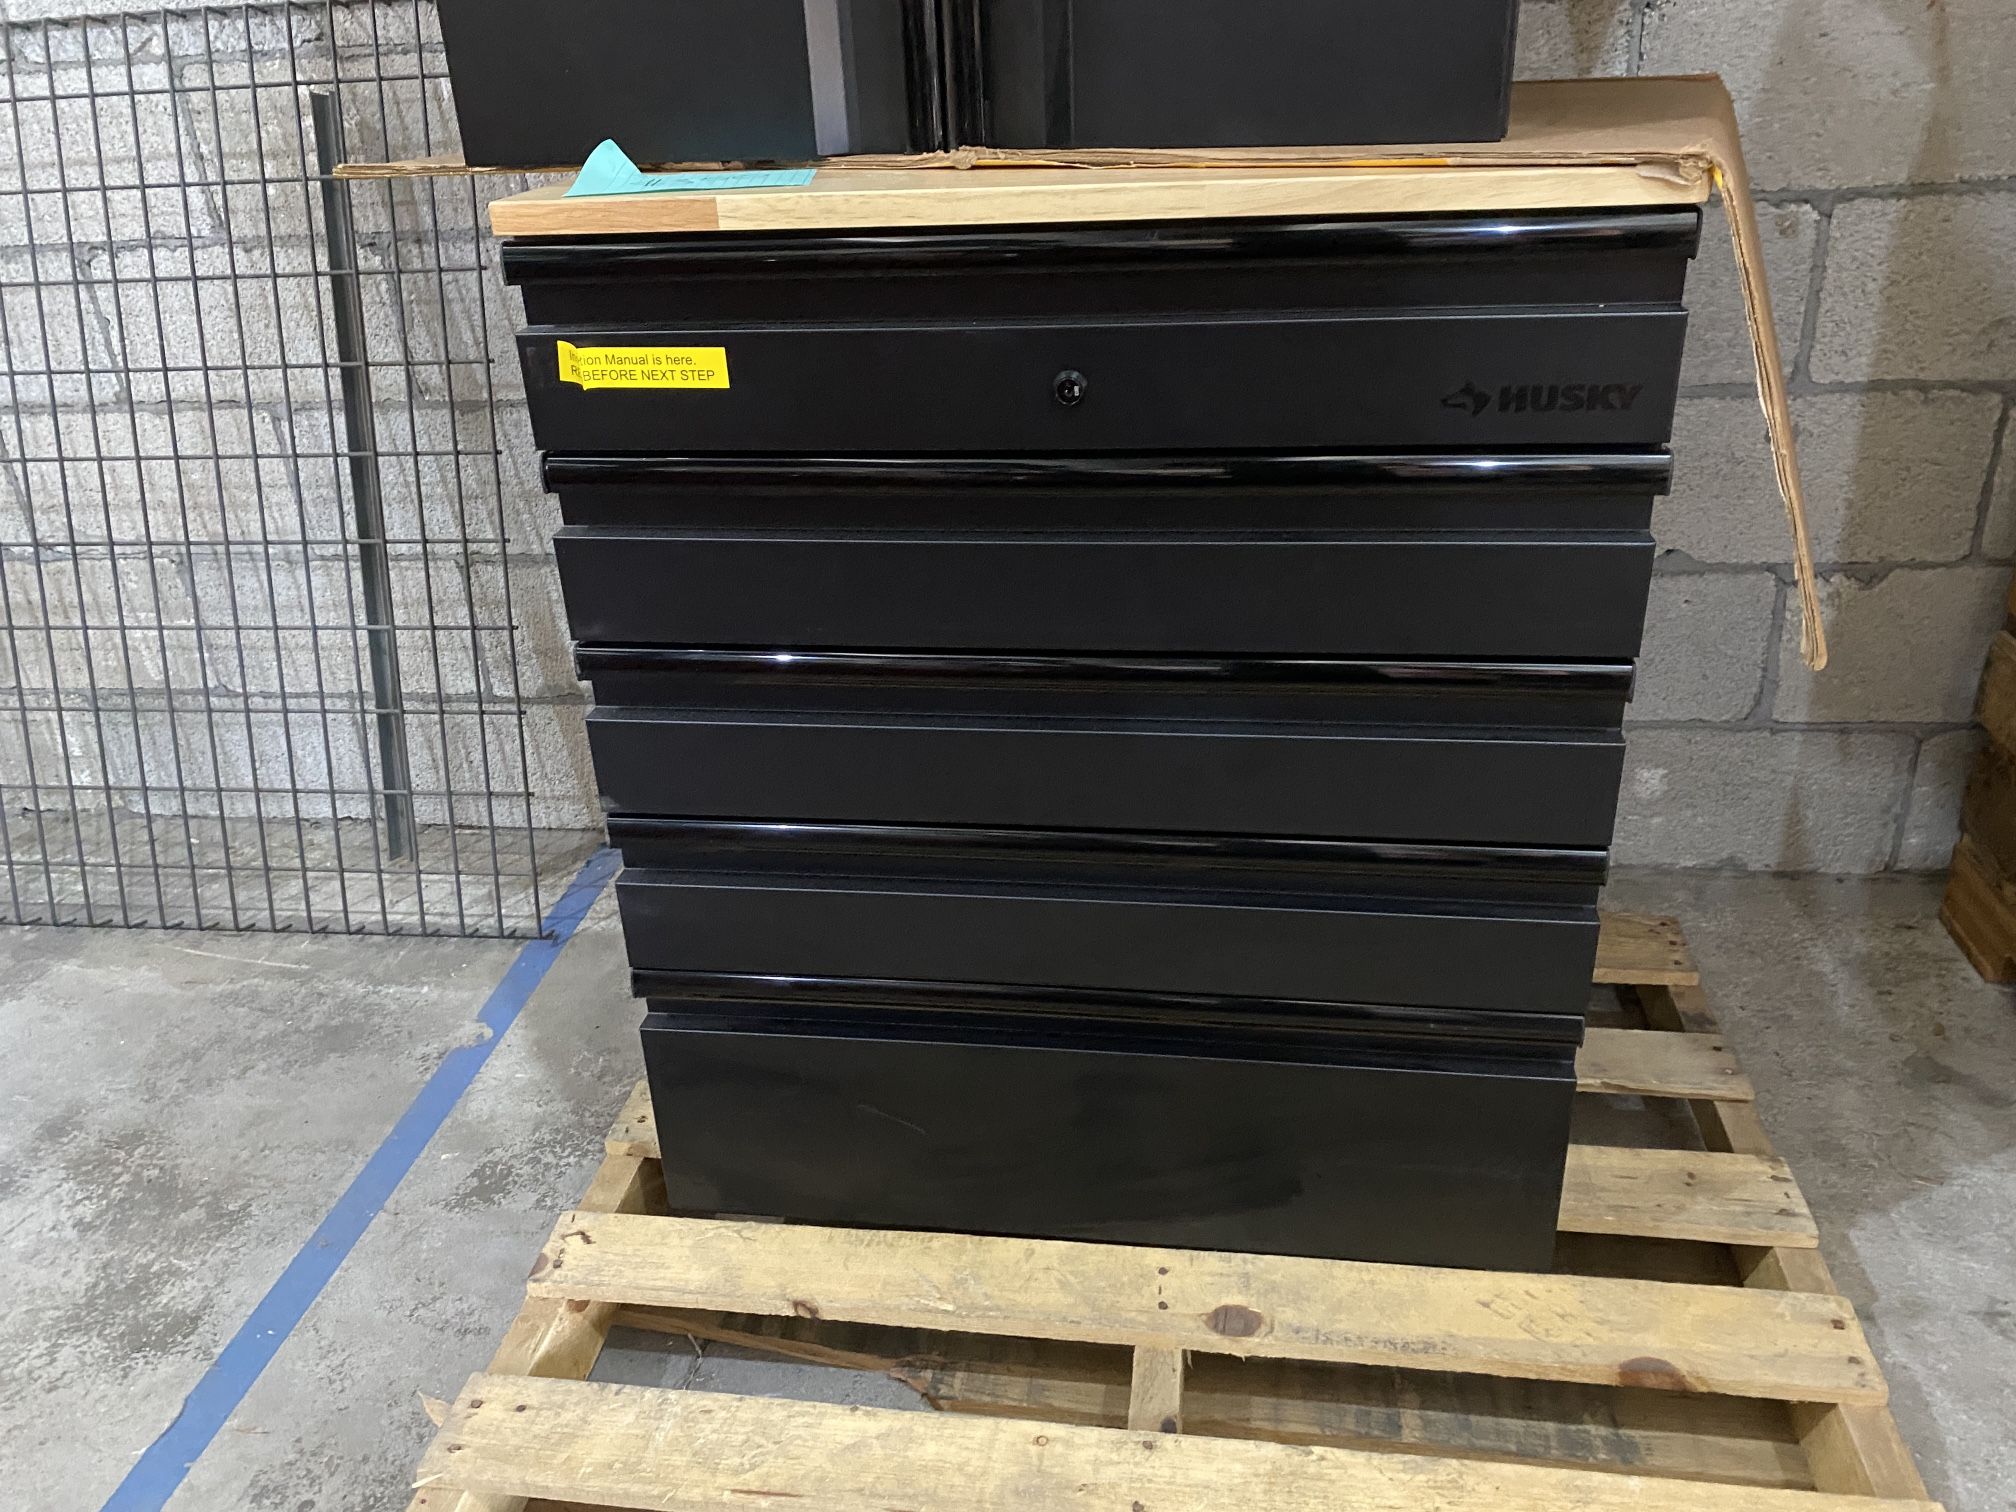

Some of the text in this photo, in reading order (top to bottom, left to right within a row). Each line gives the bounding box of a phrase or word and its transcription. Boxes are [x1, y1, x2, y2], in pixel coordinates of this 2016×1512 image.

[605, 354, 649, 366] Manual
[652, 354, 662, 366] is
[666, 354, 697, 366] here.
[583, 369, 638, 382] BEFORE
[642, 370, 678, 381] NEXT
[680, 369, 715, 381] STEP
[1498, 384, 1644, 413] HUSKY
